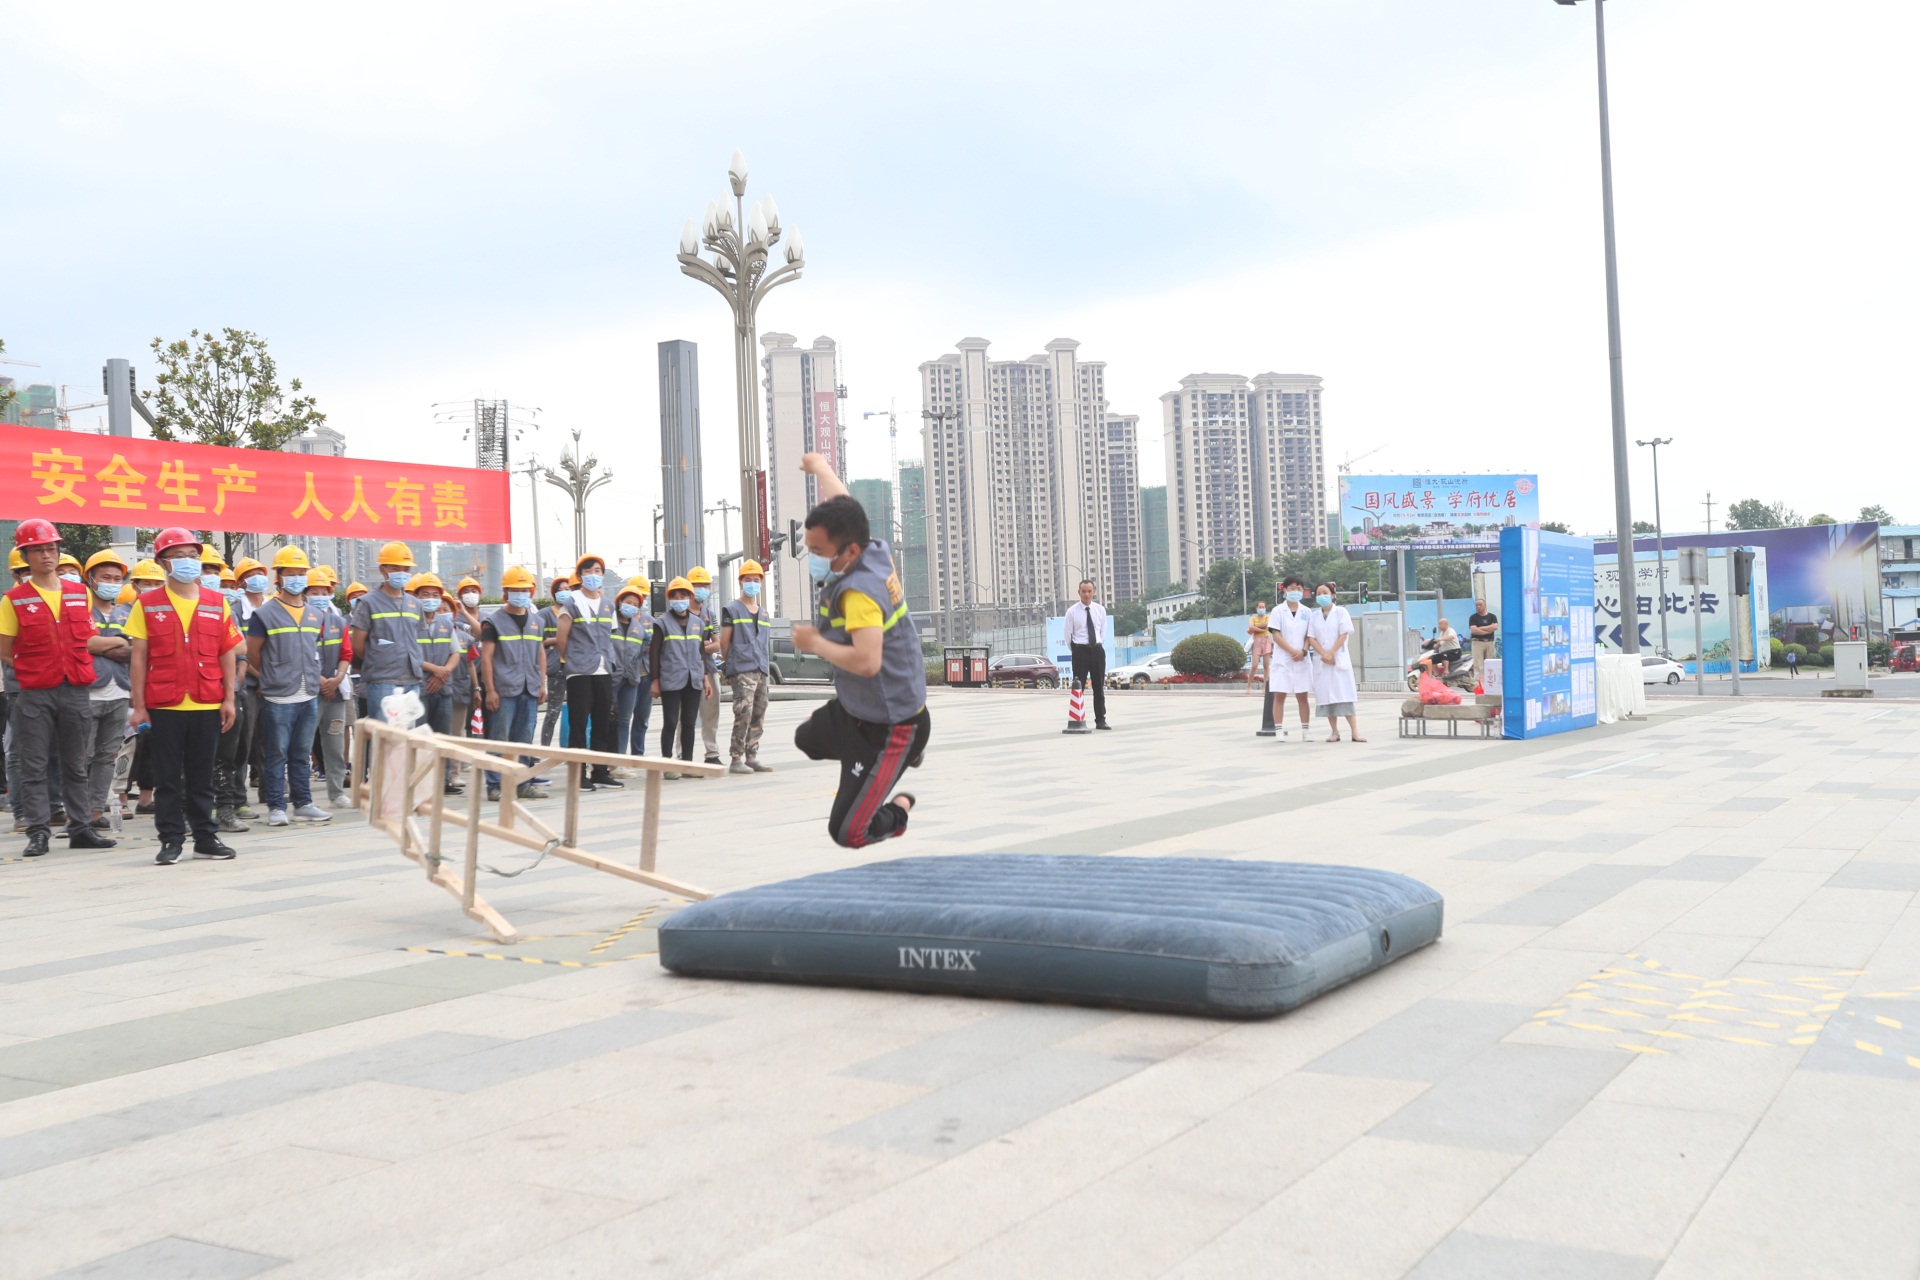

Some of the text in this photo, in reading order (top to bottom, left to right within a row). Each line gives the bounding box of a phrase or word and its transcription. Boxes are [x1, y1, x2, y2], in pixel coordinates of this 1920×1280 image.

[31, 448, 468, 529] 安全生产 人人有责
[1364, 490, 1517, 510] 国风盛景 学府优居
[898, 947, 977, 972] INTEX
